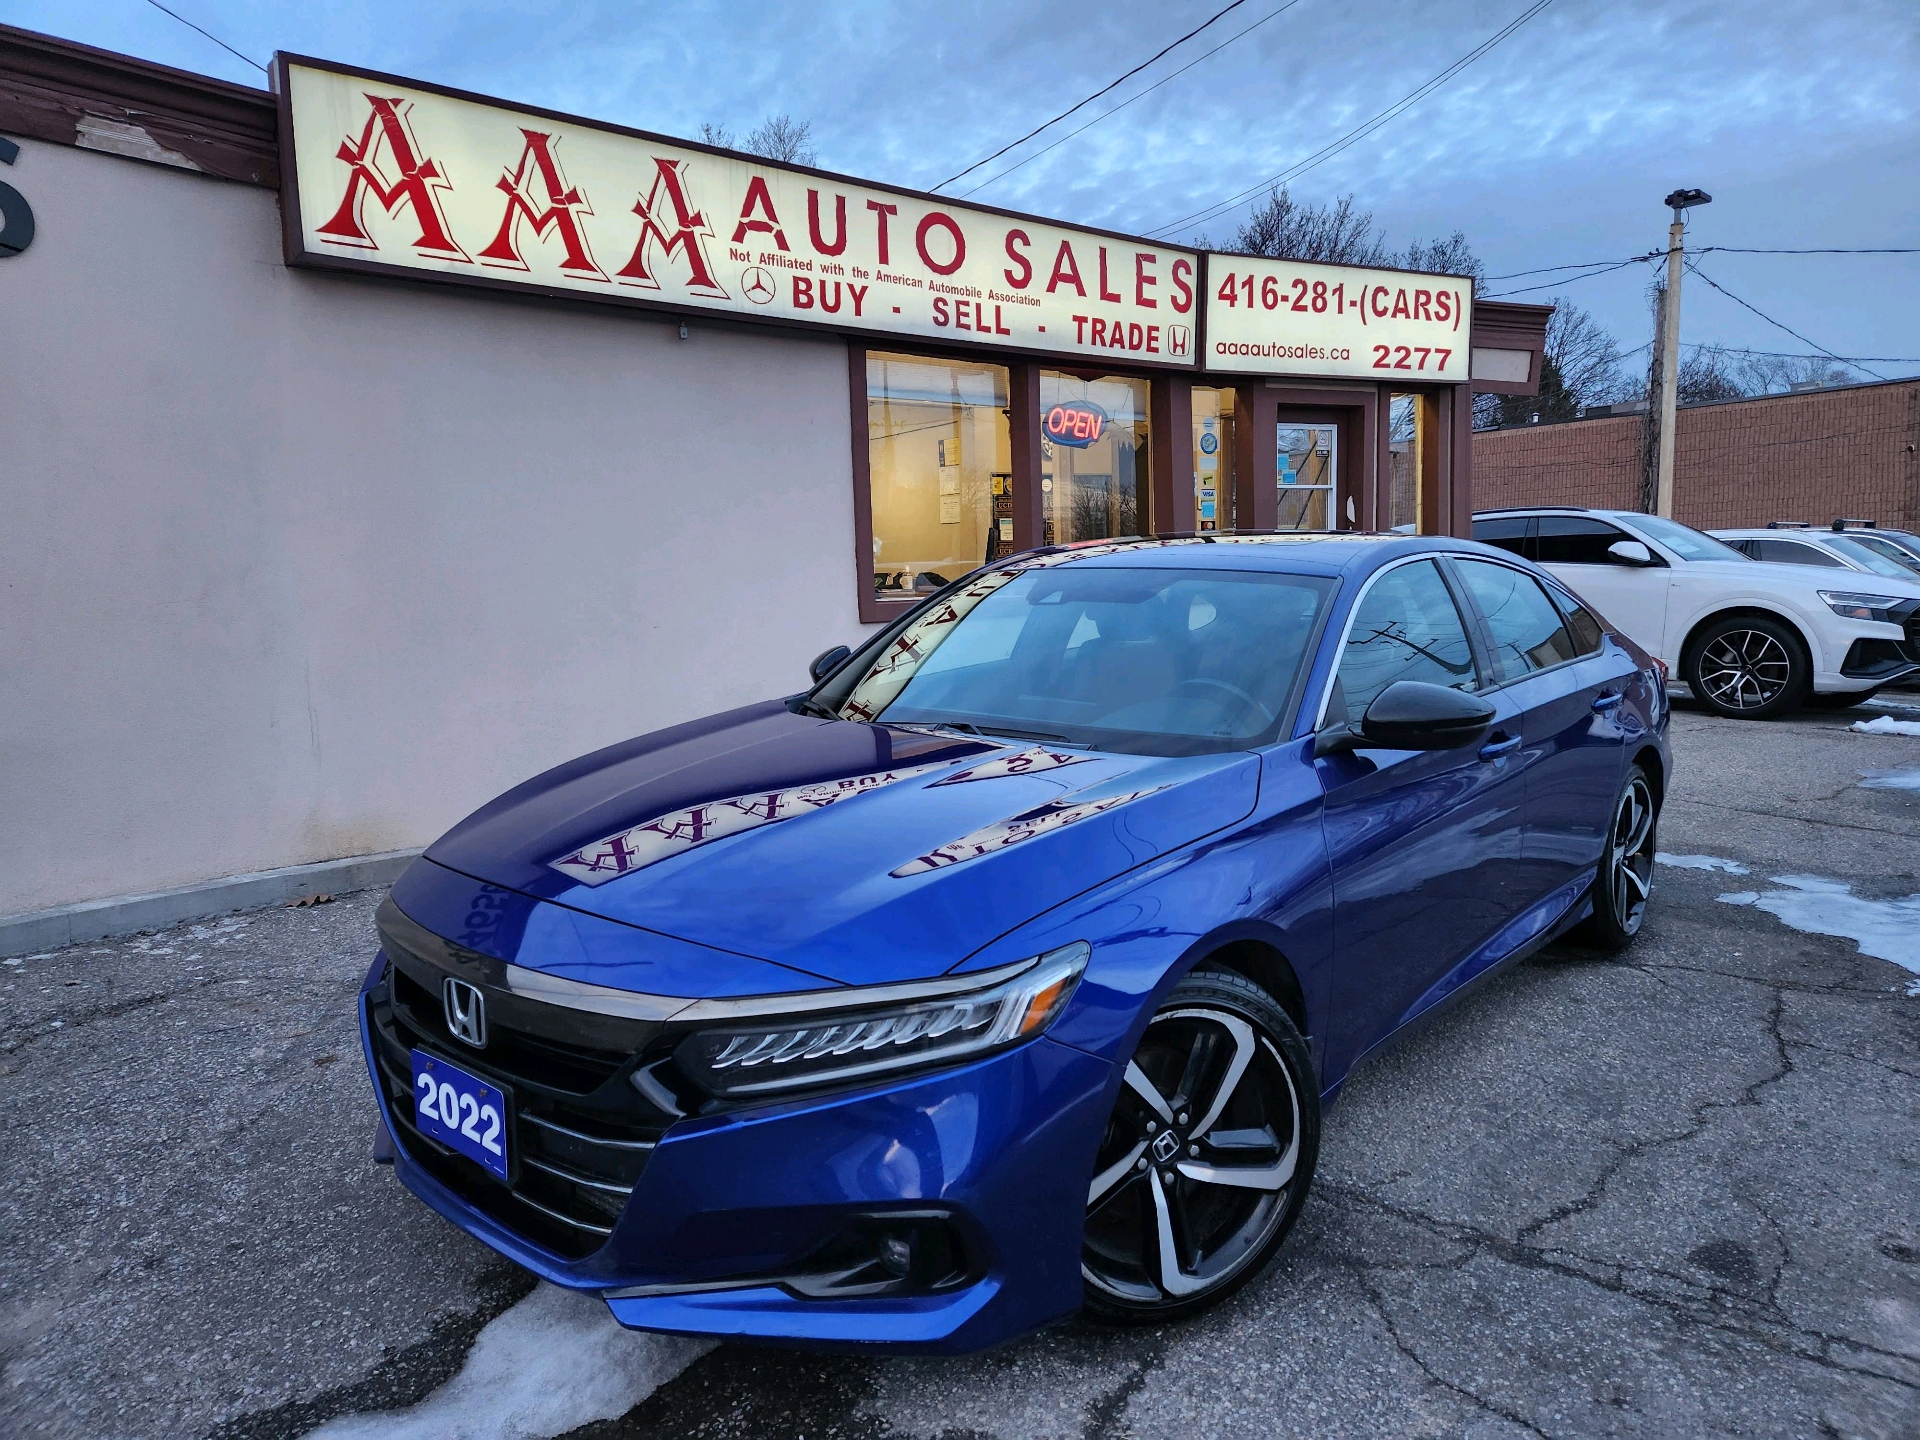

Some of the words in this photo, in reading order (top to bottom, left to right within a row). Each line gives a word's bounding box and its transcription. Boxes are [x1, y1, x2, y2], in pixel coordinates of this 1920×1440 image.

[731, 176, 966, 276] AUTO
[1004, 229, 1193, 314] SALES
[729, 248, 751, 263] Not
[759, 252, 813, 271] Affiliated
[820, 262, 845, 276] with
[852, 266, 869, 279] the
[876, 269, 923, 288] American
[928, 280, 982, 299] Automobile
[988, 289, 1041, 307] Association
[1217, 272, 1462, 332] 416-281-(CARS)
[792, 275, 869, 317] BUY
[932, 296, 1011, 336] SELL
[1072, 314, 1160, 354] TRADE
[1216, 341, 1350, 361] aaaautosales.ca
[1372, 344, 1452, 372] 2277
[1048, 407, 1103, 440] OPEN
[417, 1072, 502, 1157] 2022
